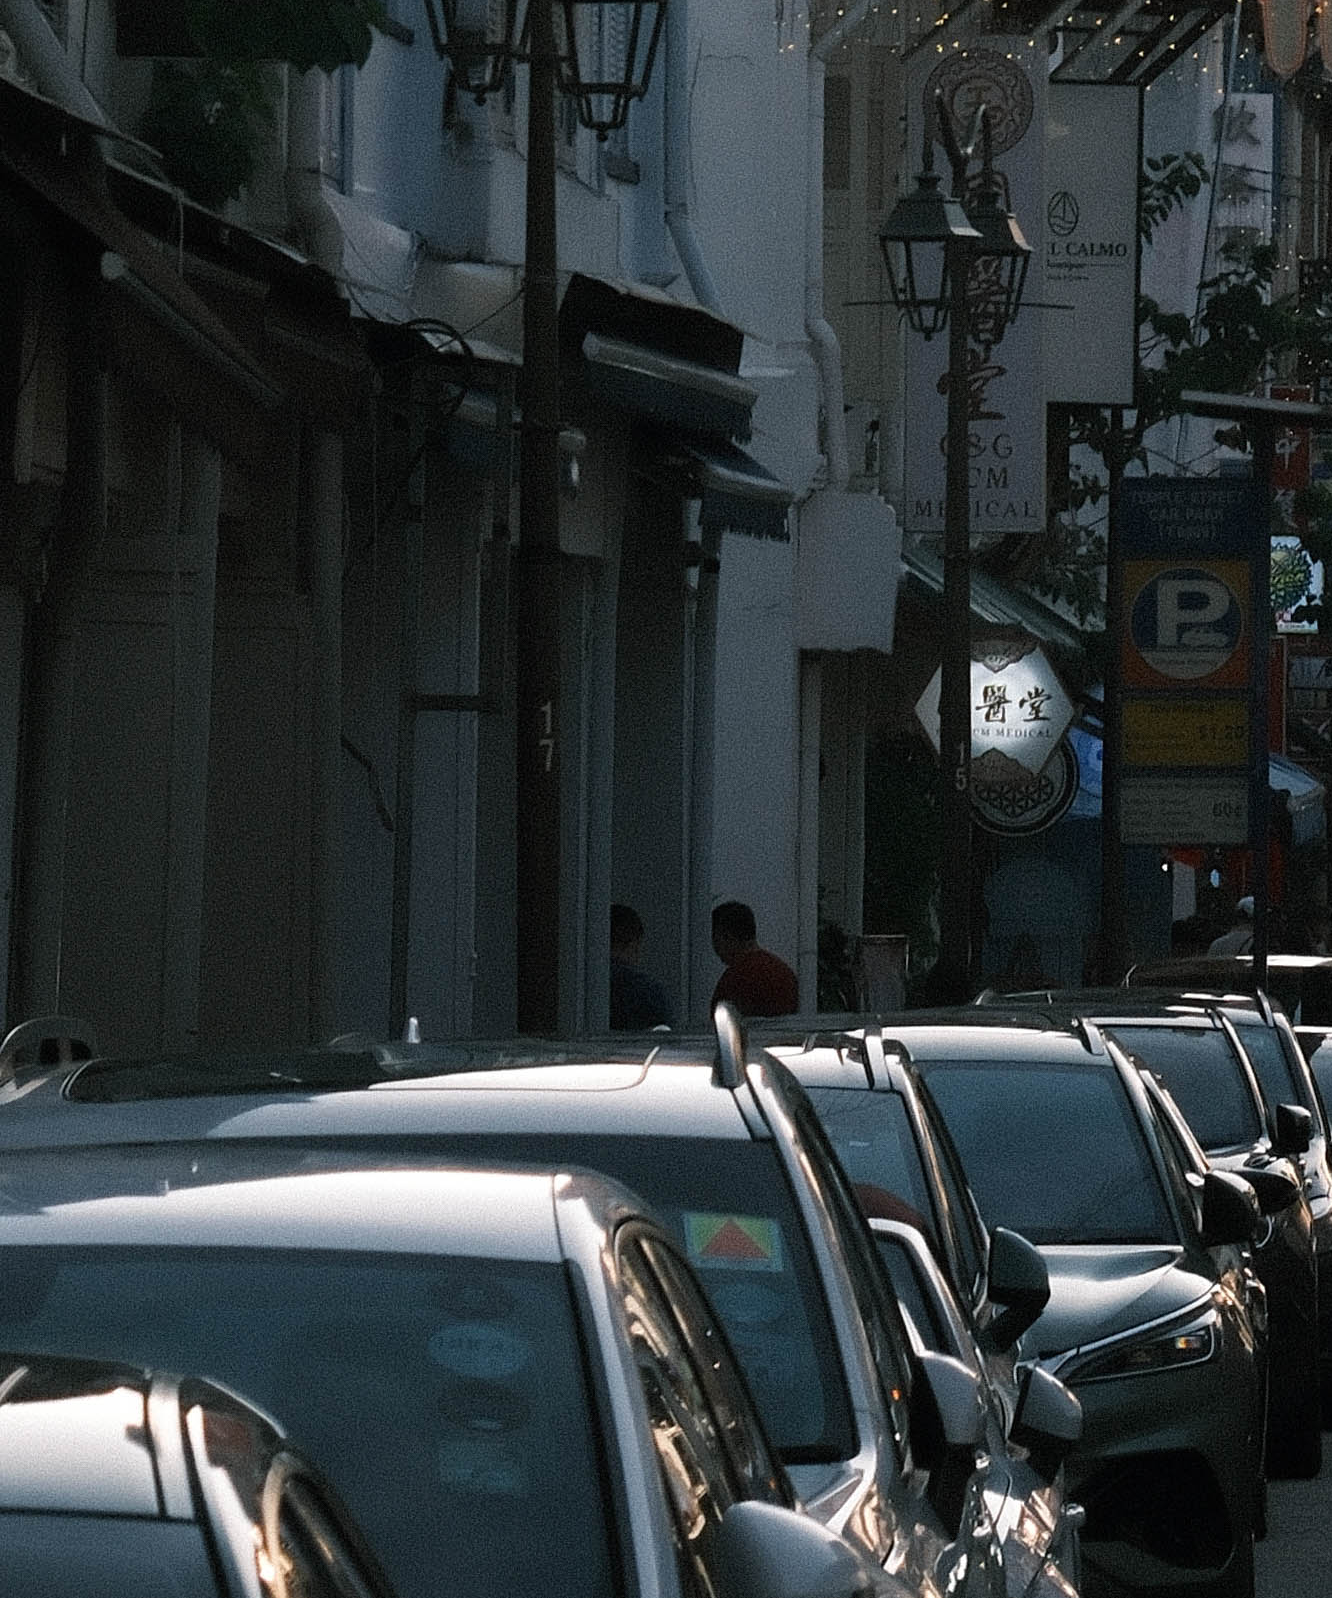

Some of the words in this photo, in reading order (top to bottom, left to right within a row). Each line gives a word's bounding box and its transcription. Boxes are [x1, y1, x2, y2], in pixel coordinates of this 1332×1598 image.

[1065, 241, 1128, 257] CALMO
[915, 499, 1037, 518] MICAL
[1157, 579, 1231, 646] P
